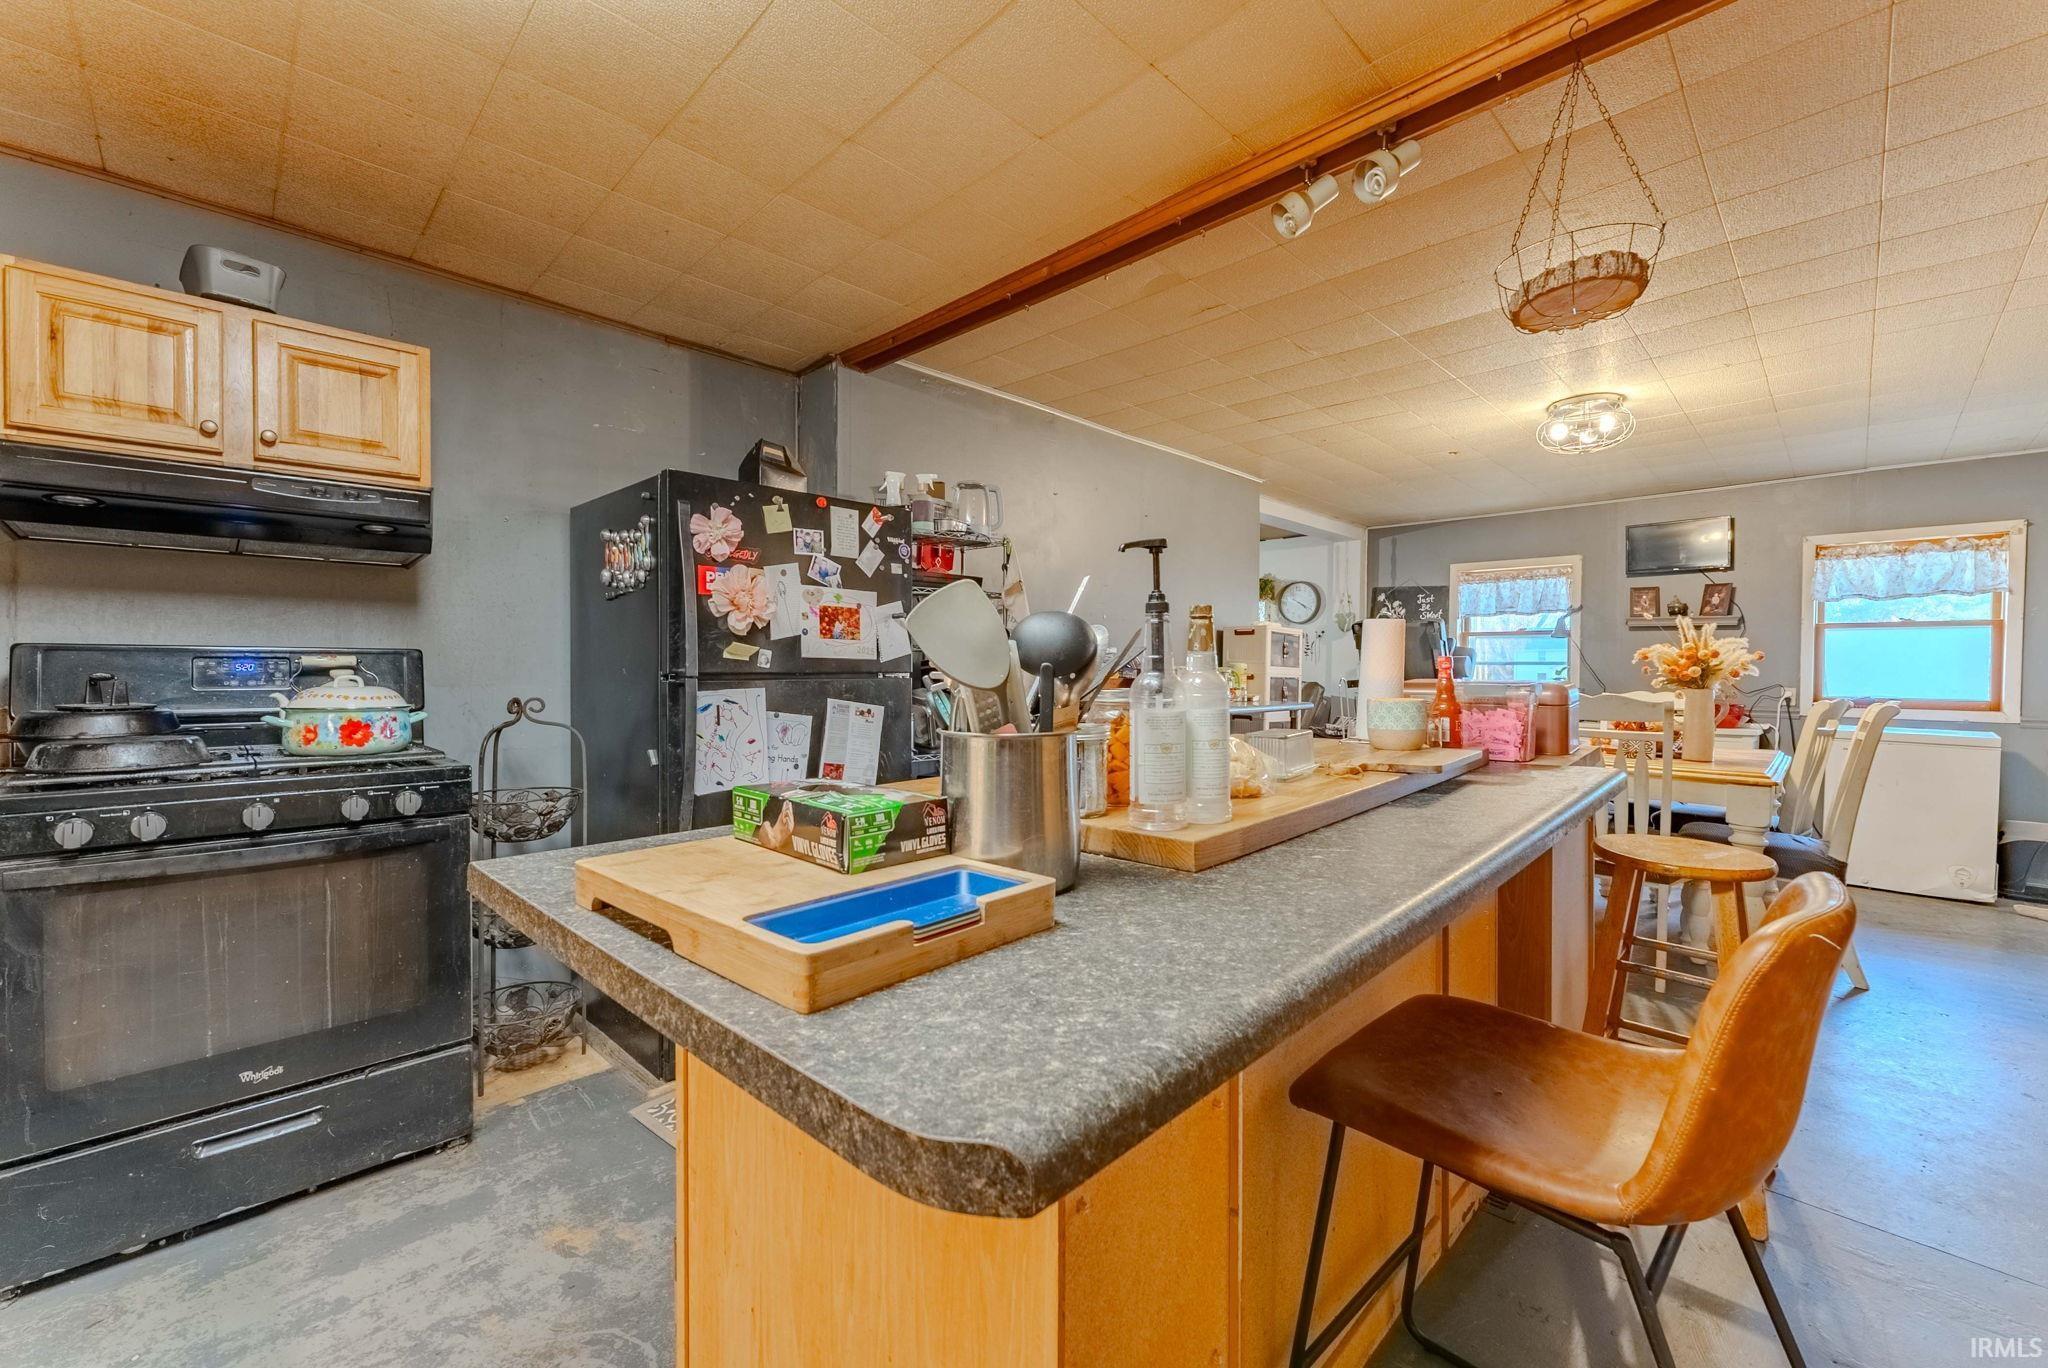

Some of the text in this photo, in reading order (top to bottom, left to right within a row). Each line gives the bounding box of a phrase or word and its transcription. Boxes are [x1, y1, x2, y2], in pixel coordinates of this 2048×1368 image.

[235, 663, 255, 671] 5:20
[778, 755, 799, 763] Hands
[924, 815, 946, 826] VENOM
[900, 838, 921, 853] VINYL
[921, 833, 946, 847] GLOVES
